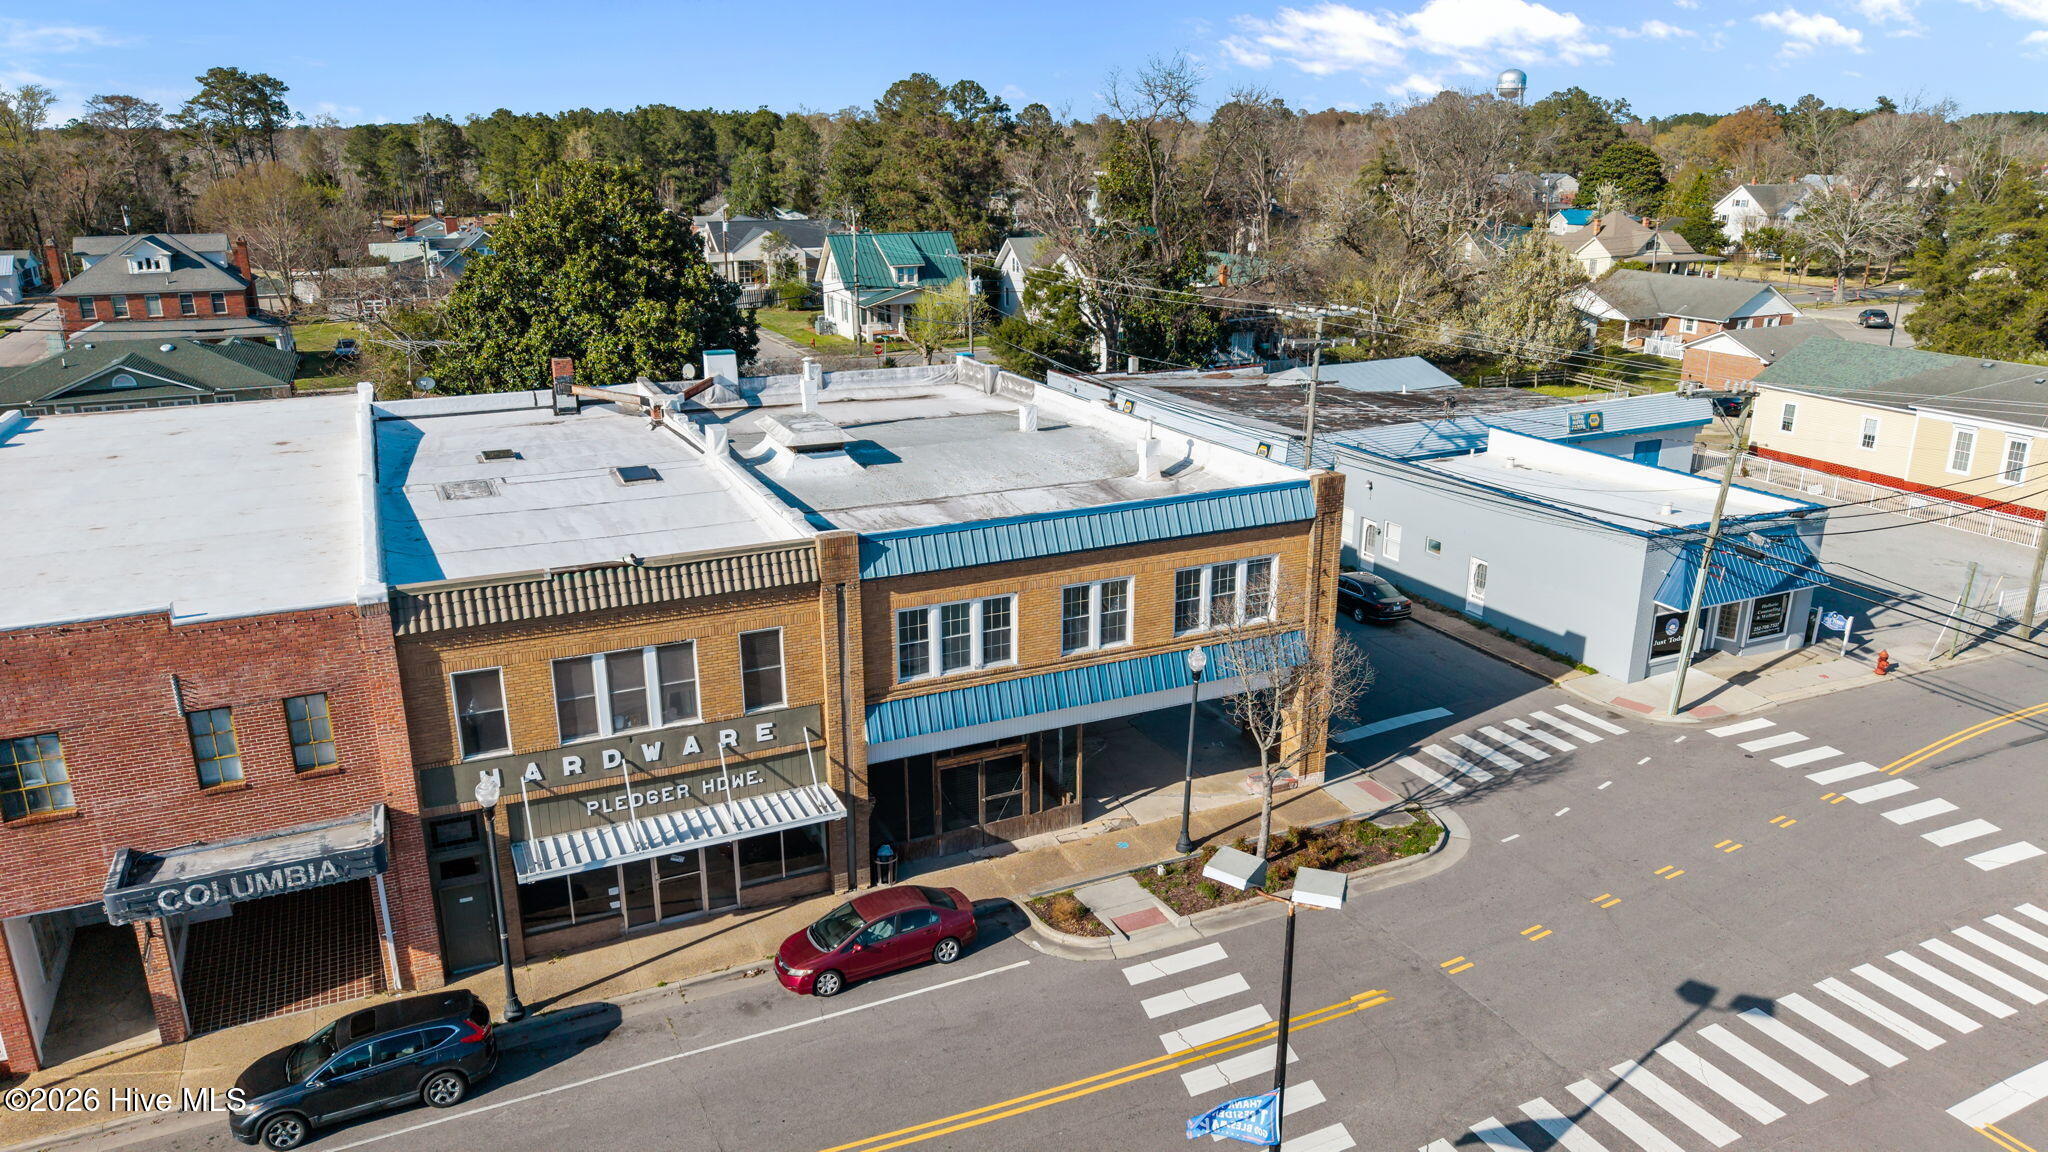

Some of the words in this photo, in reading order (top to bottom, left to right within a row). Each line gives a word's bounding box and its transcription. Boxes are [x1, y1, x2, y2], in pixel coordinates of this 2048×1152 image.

[1653, 639, 1667, 647] Just
[479, 722, 774, 787] HARDWARE
[586, 783, 690, 816] PLEDGER
[702, 770, 764, 795] HDWE.
[157, 859, 341, 911] COLUMBIA
